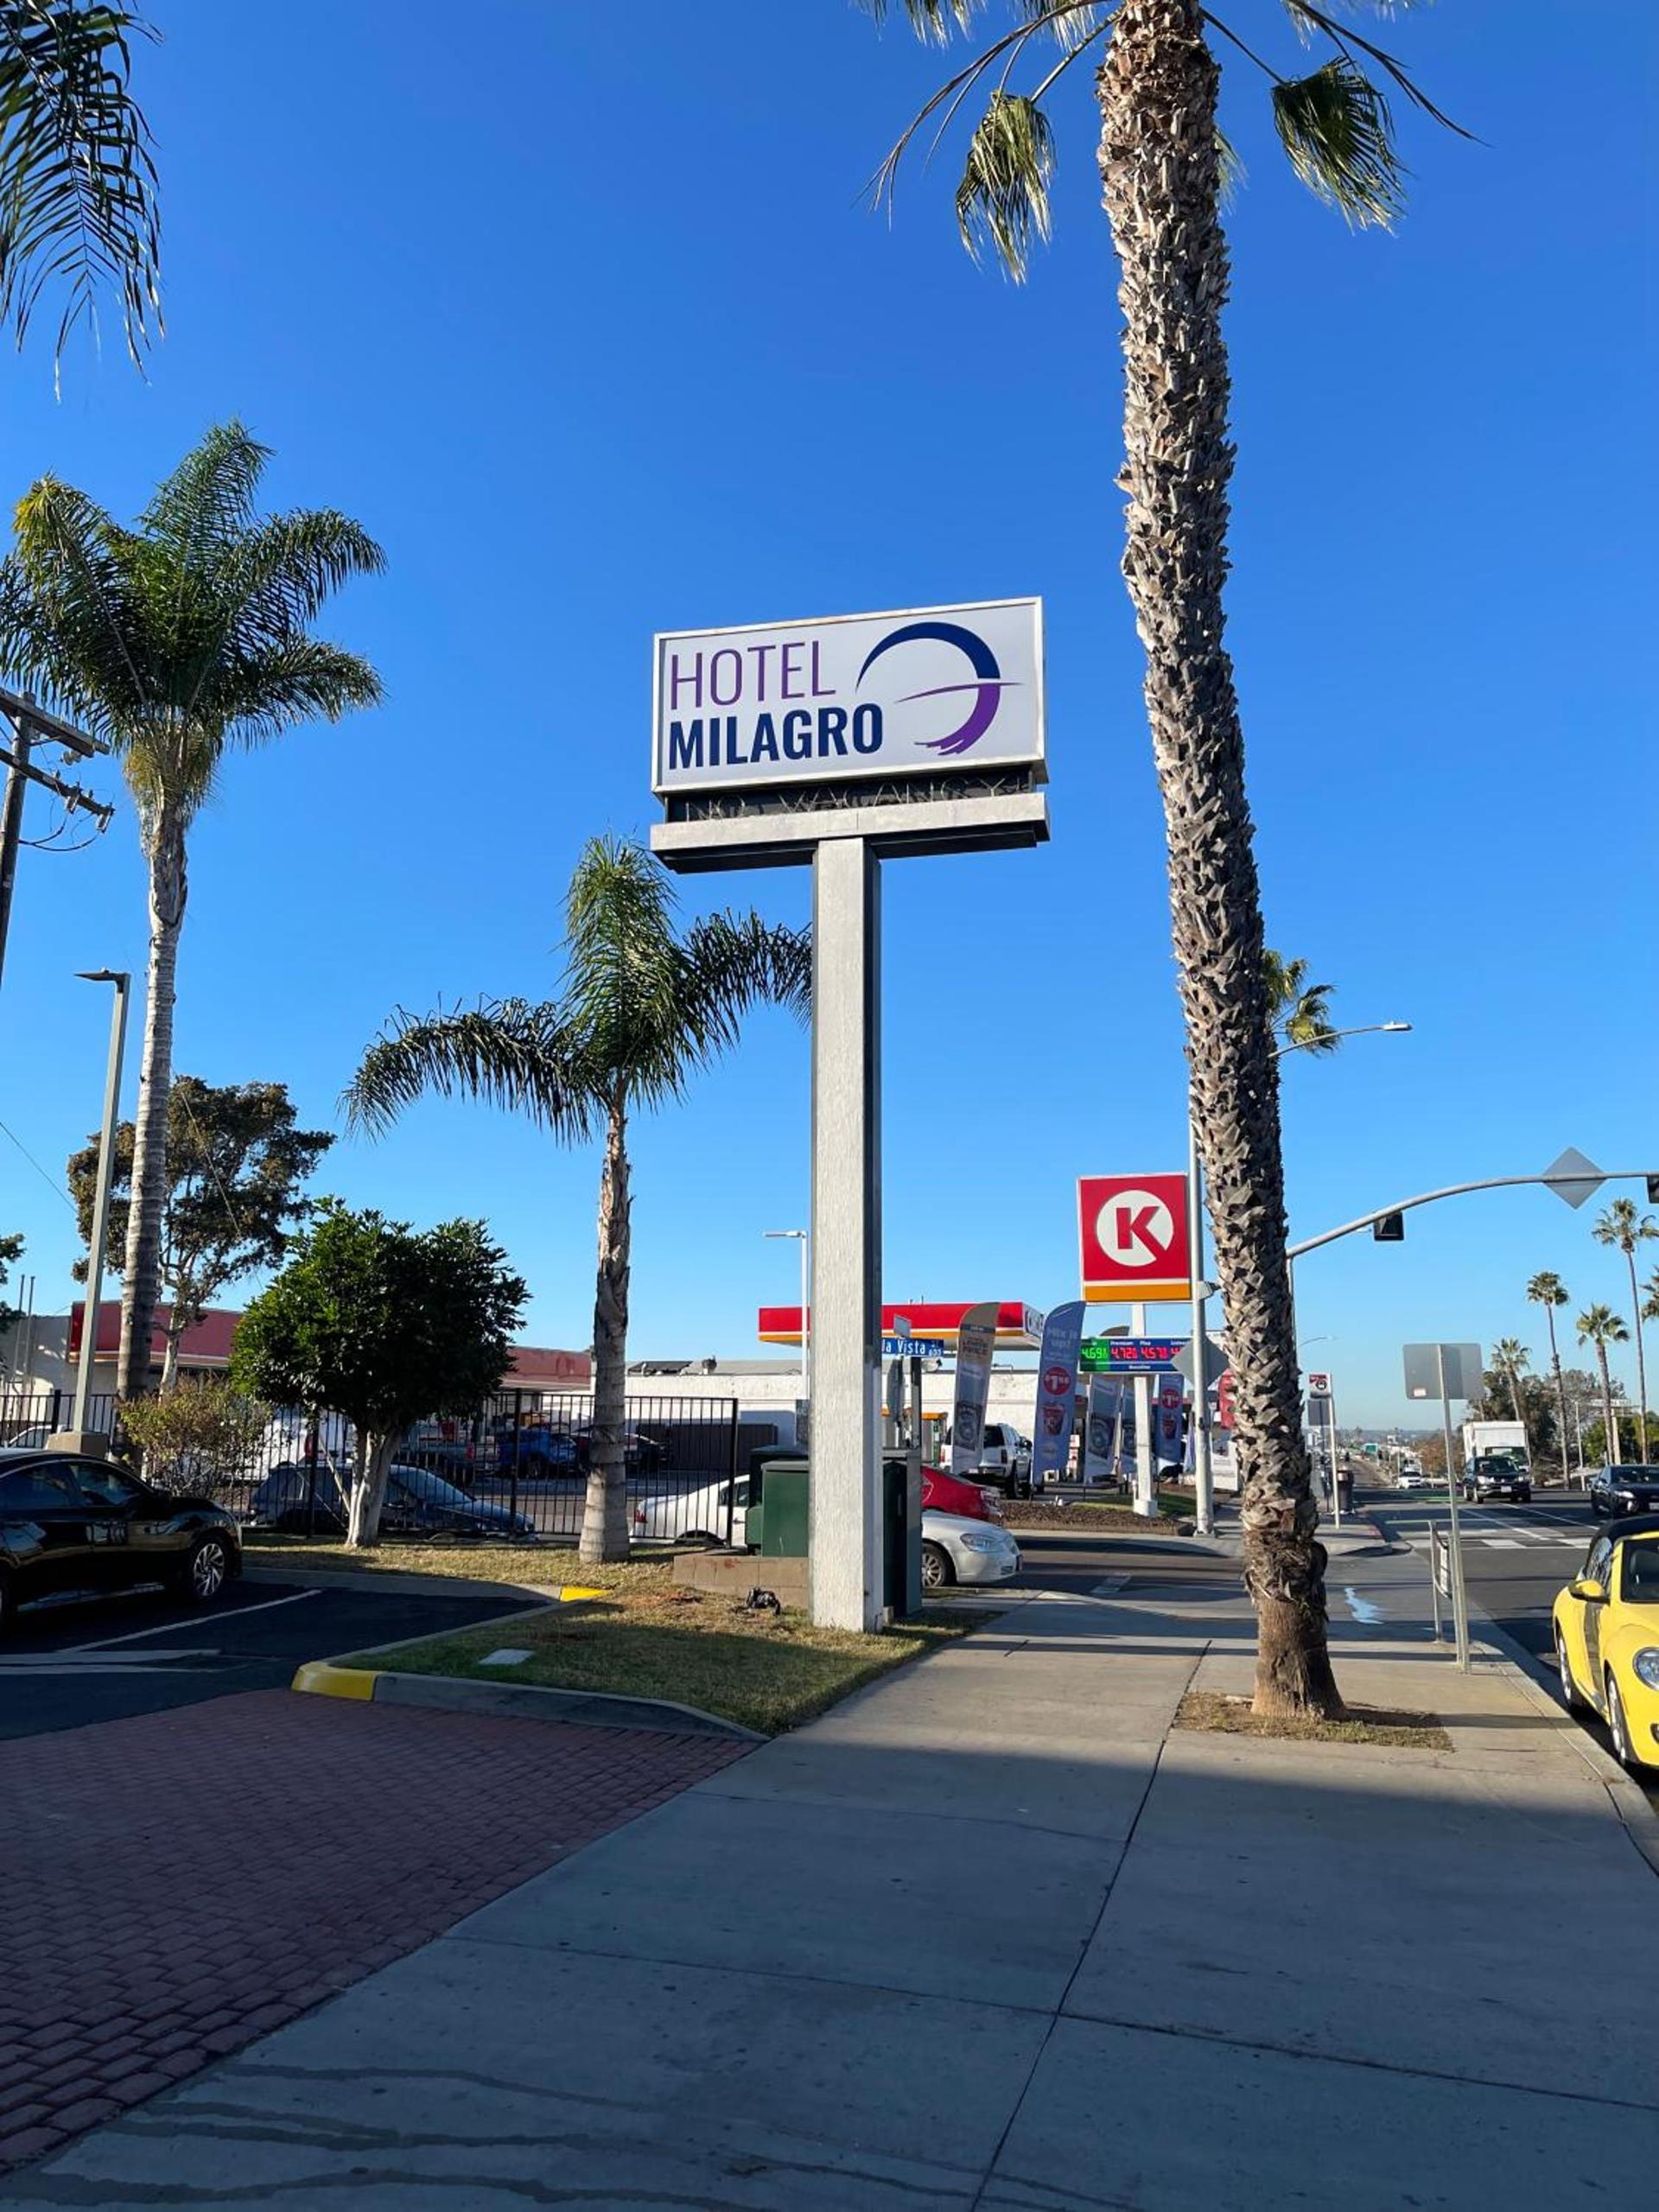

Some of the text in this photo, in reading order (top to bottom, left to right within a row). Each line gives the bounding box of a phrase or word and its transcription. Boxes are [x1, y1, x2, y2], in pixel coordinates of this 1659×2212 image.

[670, 639, 836, 710] HOTEL
[668, 702, 883, 770] MILAGRO
[1115, 1205, 1165, 1260] K
[898, 1339, 926, 1354] Vista
